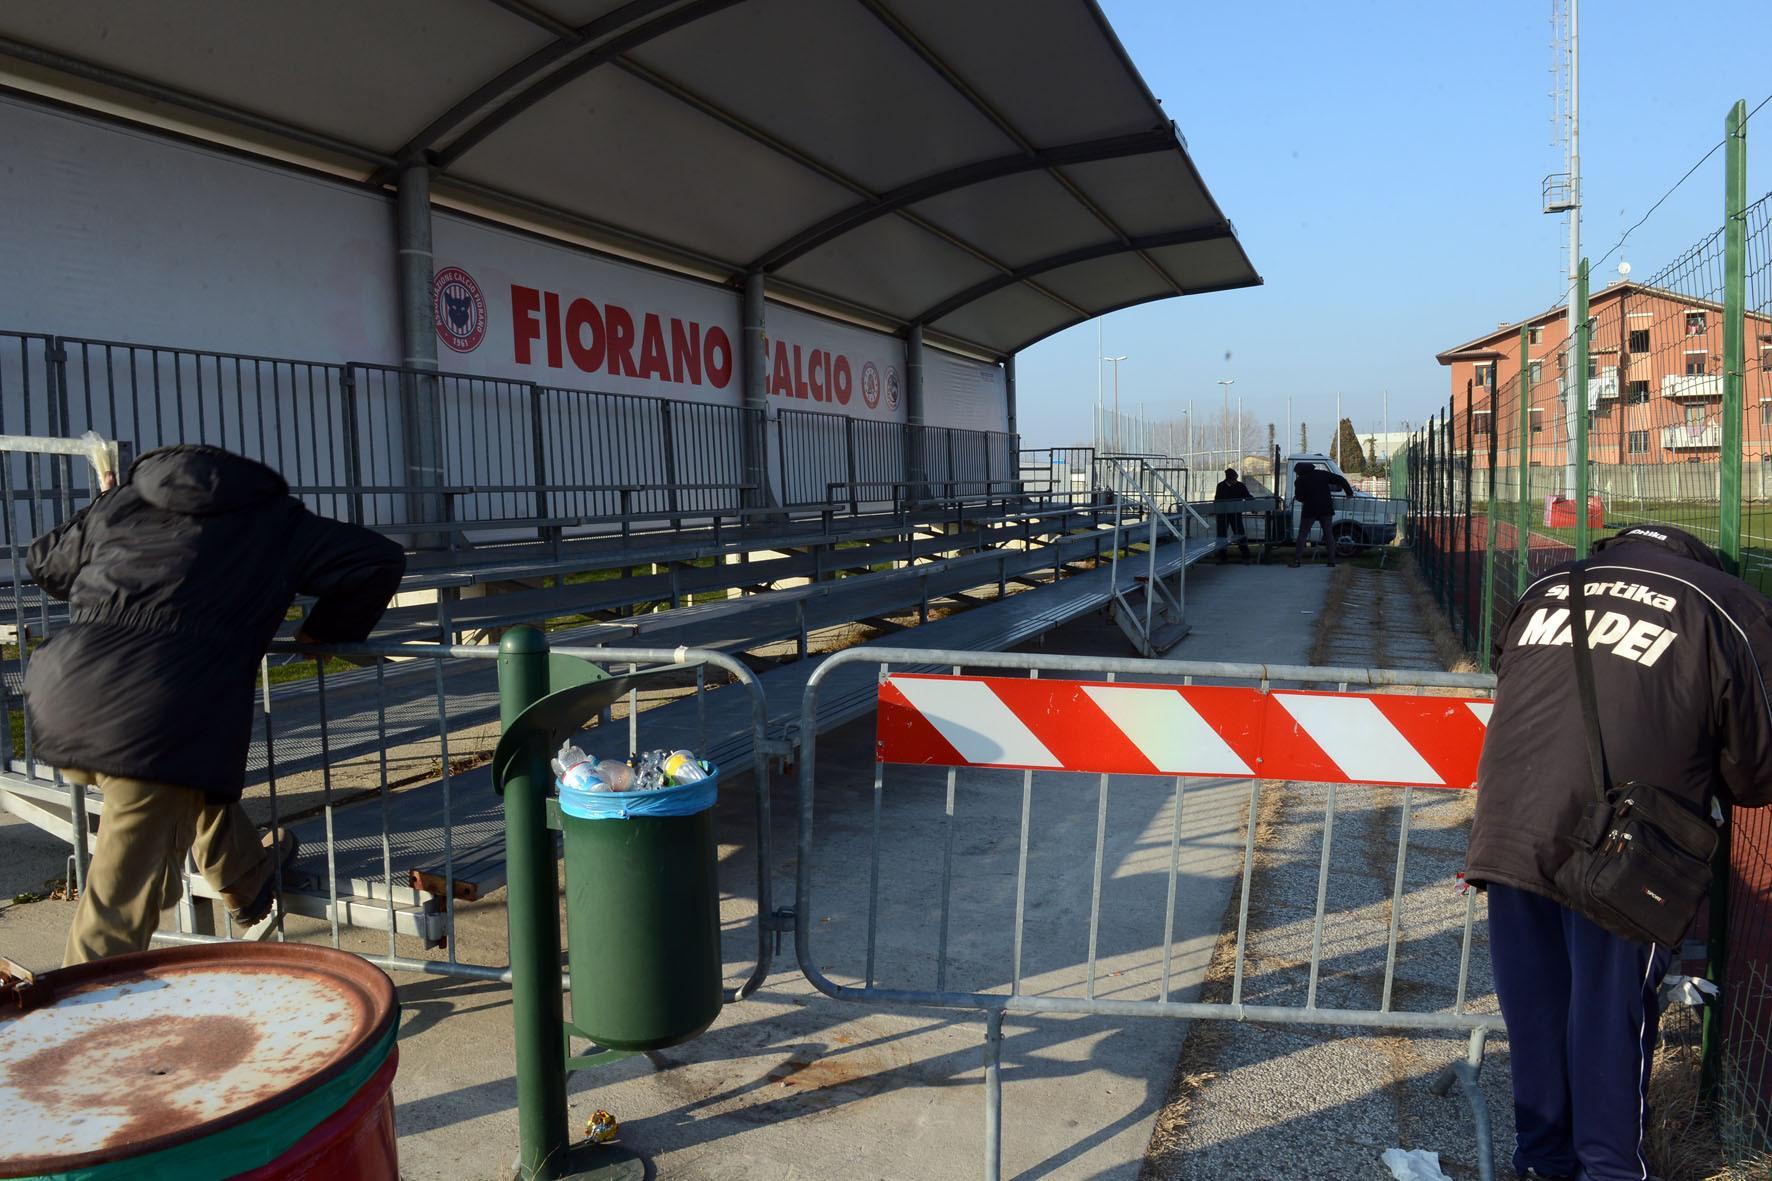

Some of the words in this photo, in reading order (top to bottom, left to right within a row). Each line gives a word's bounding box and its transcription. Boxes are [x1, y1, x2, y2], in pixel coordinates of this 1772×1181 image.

[453, 338, 469, 347] 1961
[511, 284, 733, 389] FIORANO
[1518, 608, 1678, 667] MAPEI
